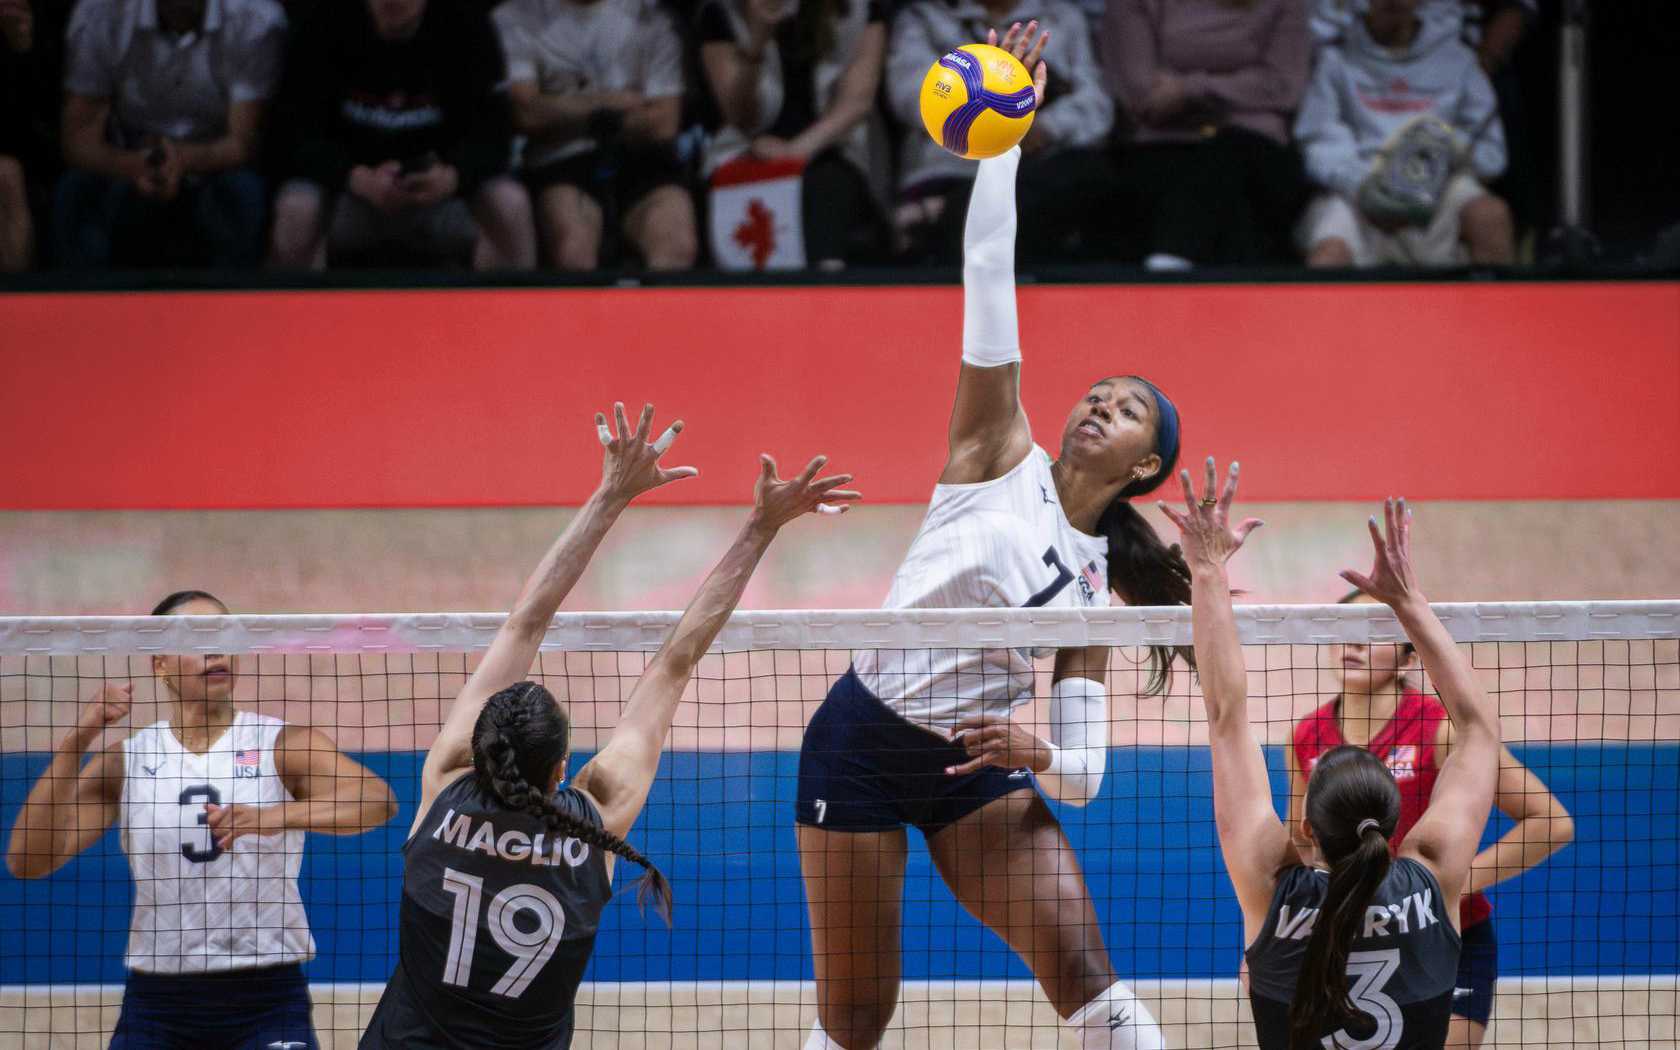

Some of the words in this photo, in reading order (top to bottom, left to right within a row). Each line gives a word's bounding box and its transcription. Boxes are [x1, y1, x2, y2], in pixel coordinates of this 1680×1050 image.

[1020, 545, 1076, 607] 7
[235, 766, 261, 778] USA
[179, 784, 222, 863] 3
[433, 808, 589, 867] MAGLIO
[815, 799, 827, 823] 7
[442, 867, 566, 998] 19
[1320, 948, 1404, 1050] 3
